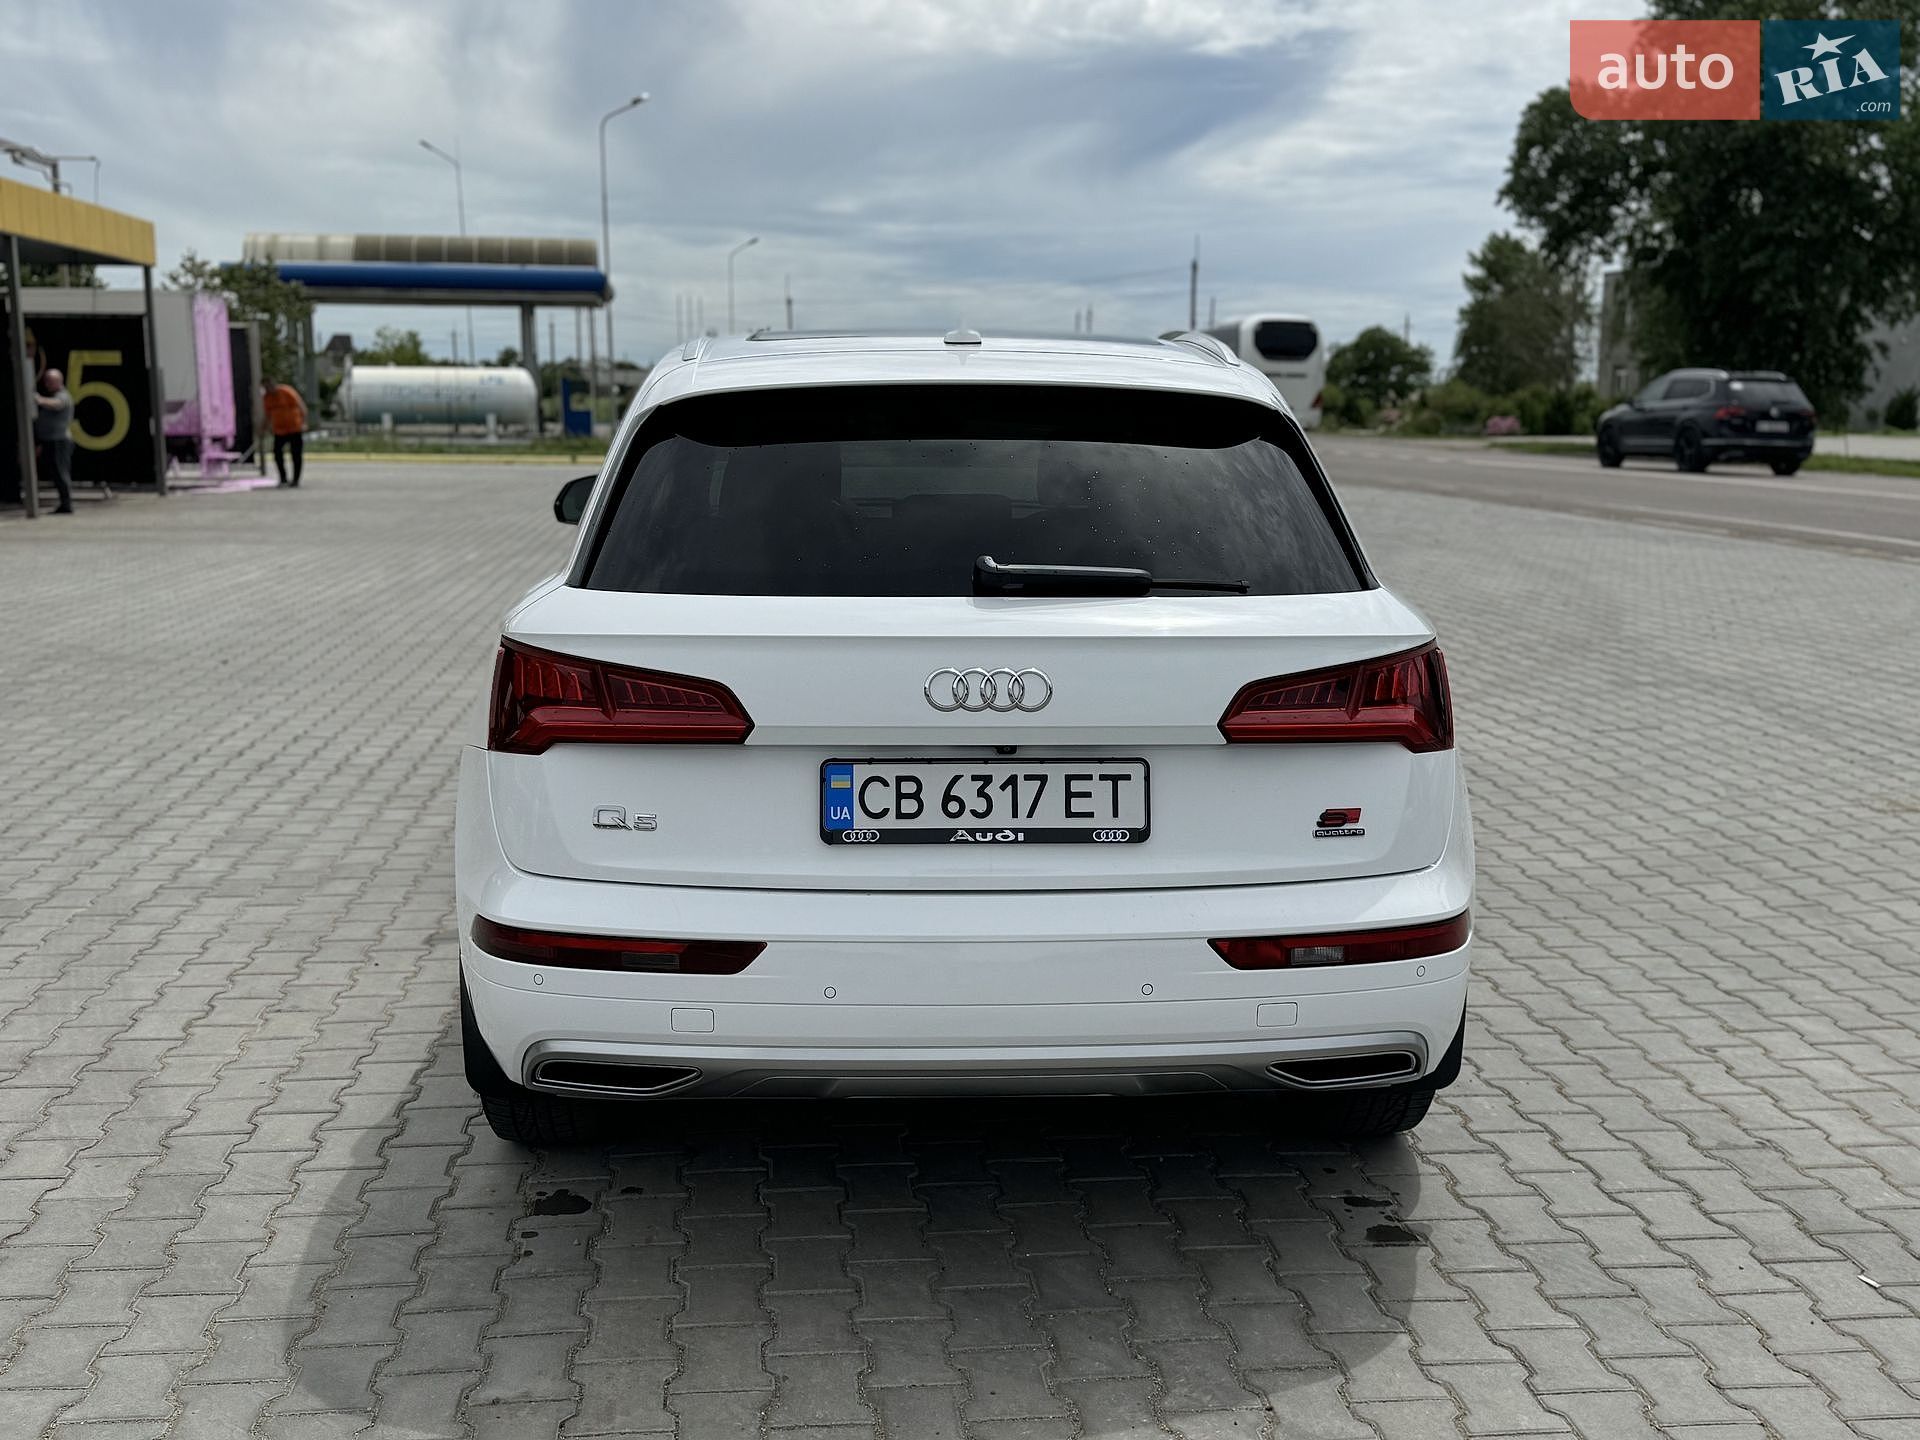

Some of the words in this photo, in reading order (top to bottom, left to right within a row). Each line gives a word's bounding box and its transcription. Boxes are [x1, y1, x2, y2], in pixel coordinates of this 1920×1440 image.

[66, 350, 131, 451] 5
[858, 775, 925, 820] CB
[940, 774, 1049, 819] 6317
[1064, 773, 1132, 818] ET
[592, 804, 658, 831] Q5
[830, 806, 851, 820] UA
[949, 830, 1024, 842] Audi
[1315, 828, 1365, 837] quattro
